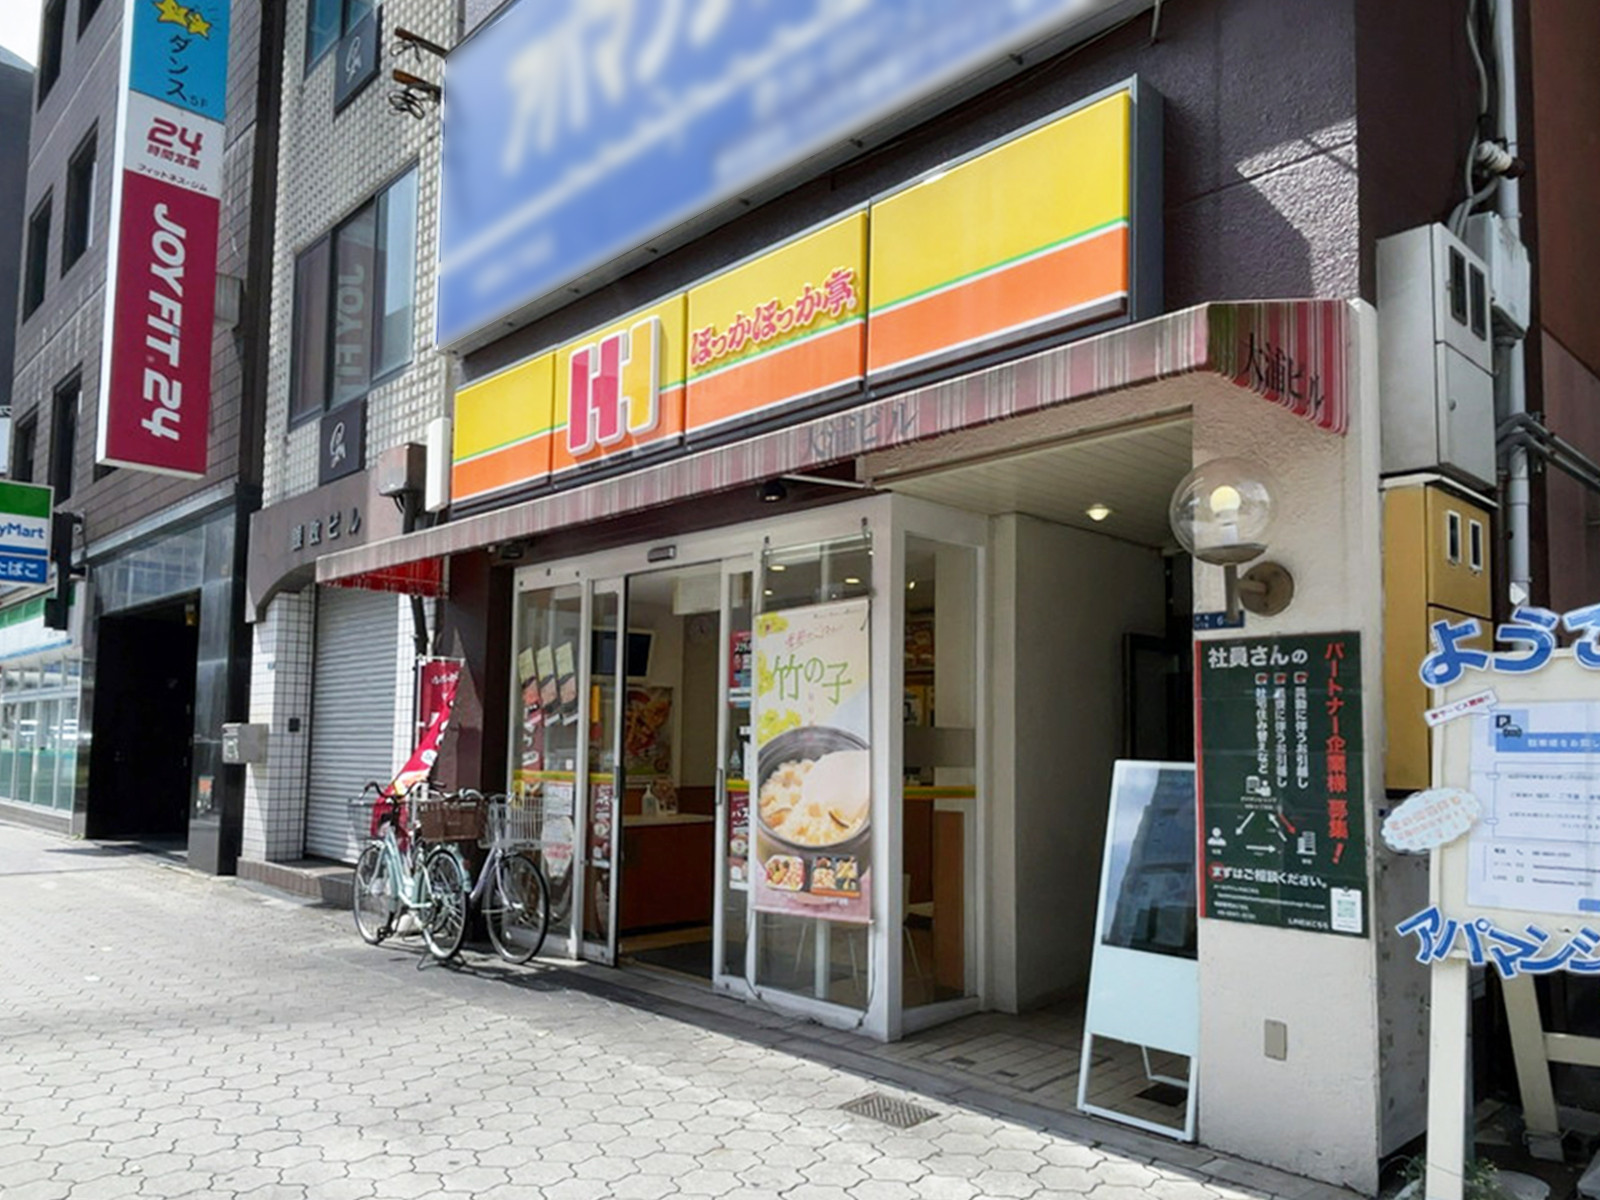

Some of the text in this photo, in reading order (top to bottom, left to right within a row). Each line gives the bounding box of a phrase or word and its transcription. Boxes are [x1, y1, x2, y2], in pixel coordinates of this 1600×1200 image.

[166, 34, 192, 101] ダンス
[147, 117, 203, 157] 24
[690, 268, 857, 367] ほっかほっか亭
[772, 654, 852, 705] 竹の子
[1208, 645, 1308, 668] 社員さんの
